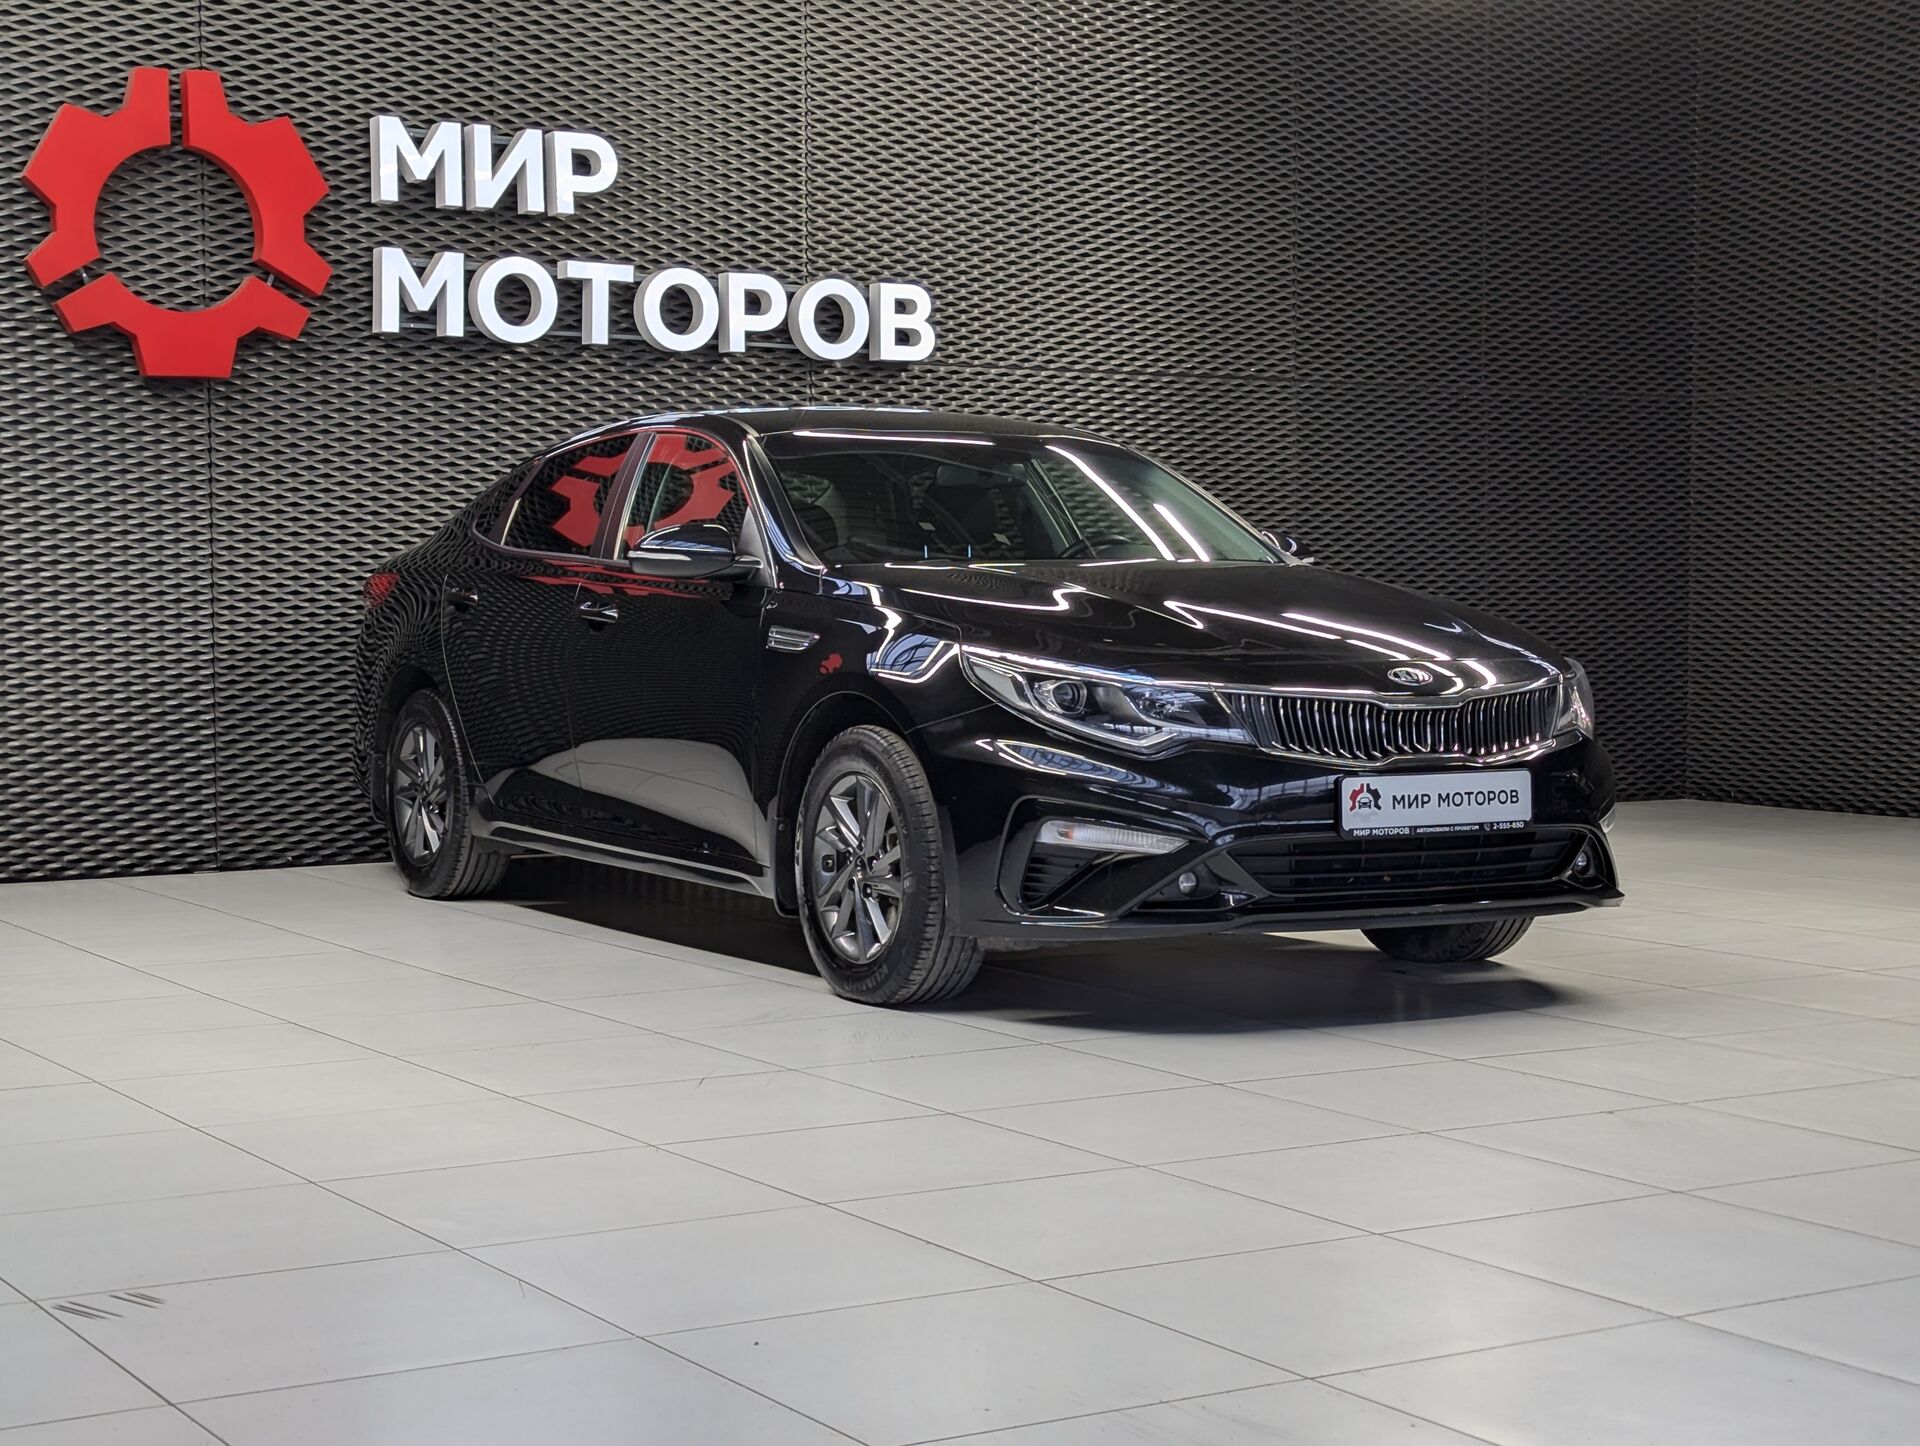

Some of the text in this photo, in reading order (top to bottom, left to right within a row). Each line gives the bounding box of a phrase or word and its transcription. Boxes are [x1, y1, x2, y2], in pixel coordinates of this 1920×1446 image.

[369, 115, 618, 217] МИР
[372, 246, 936, 362] МОТОРОВ
[1392, 789, 1520, 810] МИР МОТОРОВ
[1353, 827, 1410, 837] МИР МОТОРОВ
